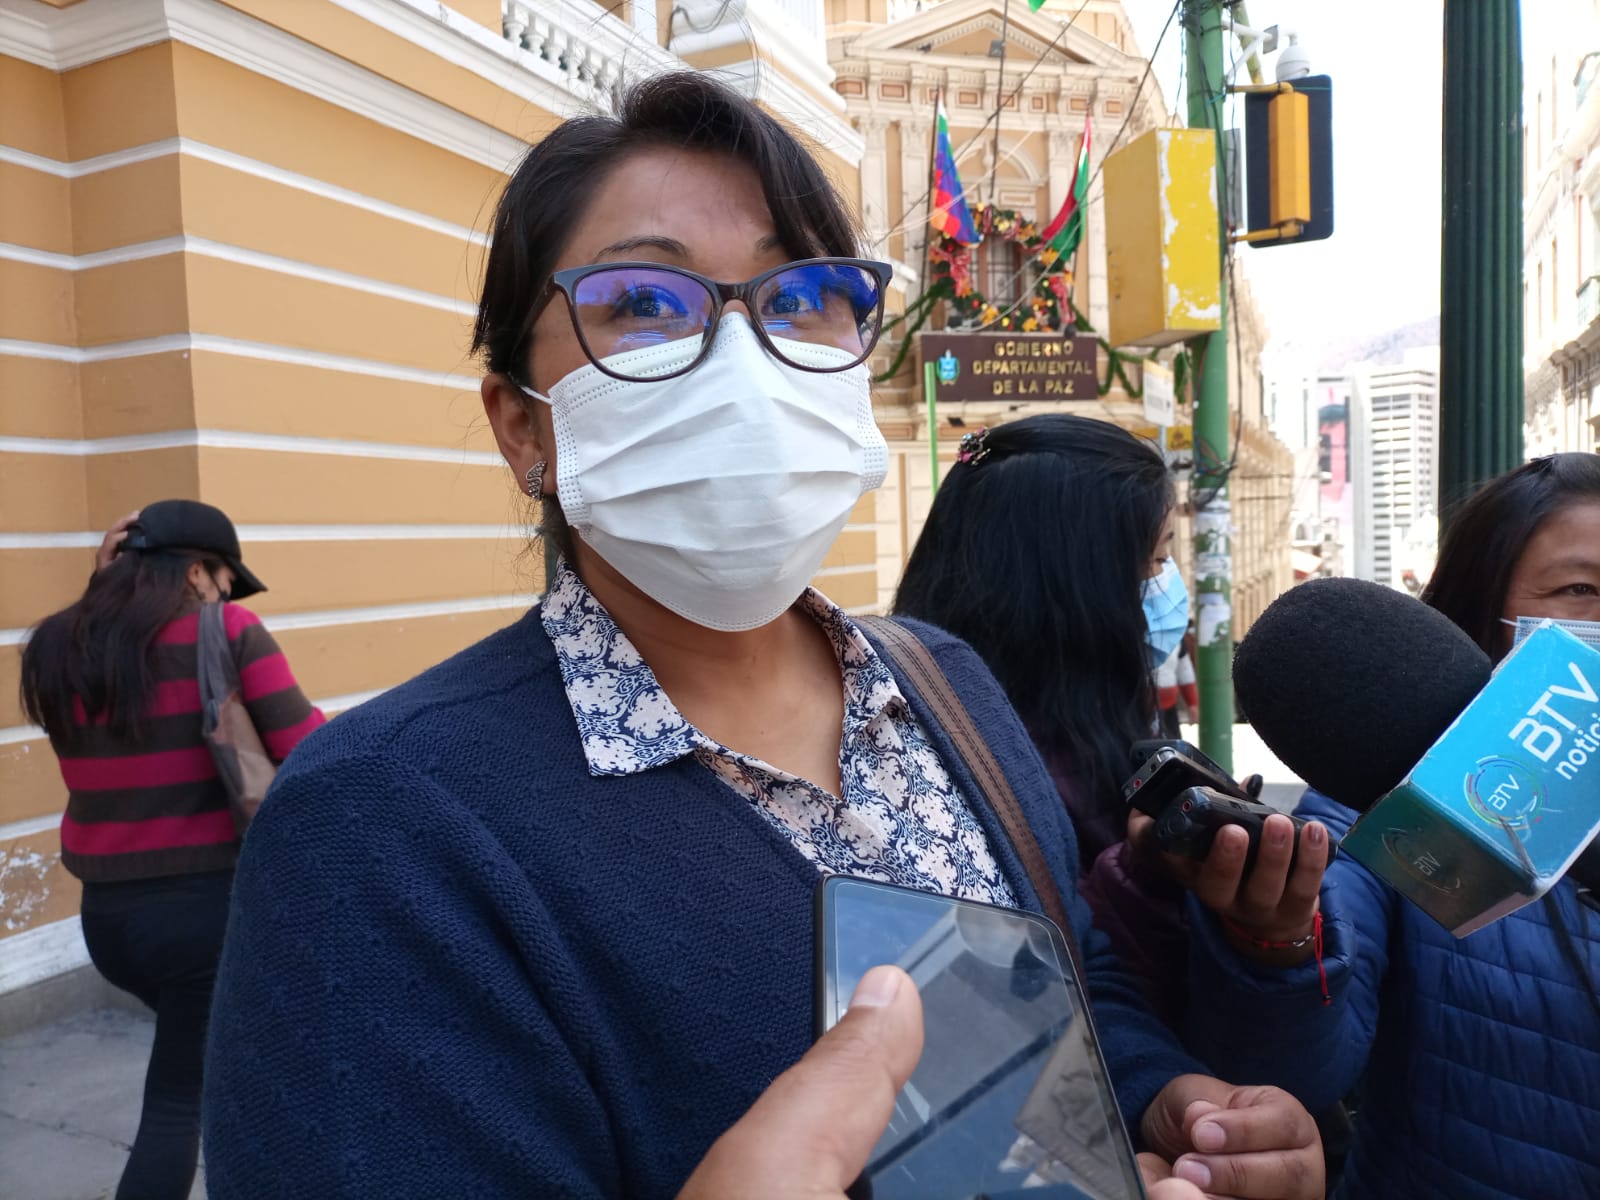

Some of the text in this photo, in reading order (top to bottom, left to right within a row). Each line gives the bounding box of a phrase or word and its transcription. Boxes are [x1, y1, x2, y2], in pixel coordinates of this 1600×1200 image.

[994, 340, 1073, 357] GOBIERNO
[972, 360, 1092, 376] DEPARTAMENTAL
[993, 379, 1074, 395] DE LA PAZ
[1508, 661, 1600, 763] BTV
[1487, 773, 1521, 811] BTV
[1412, 850, 1441, 877] BTV
